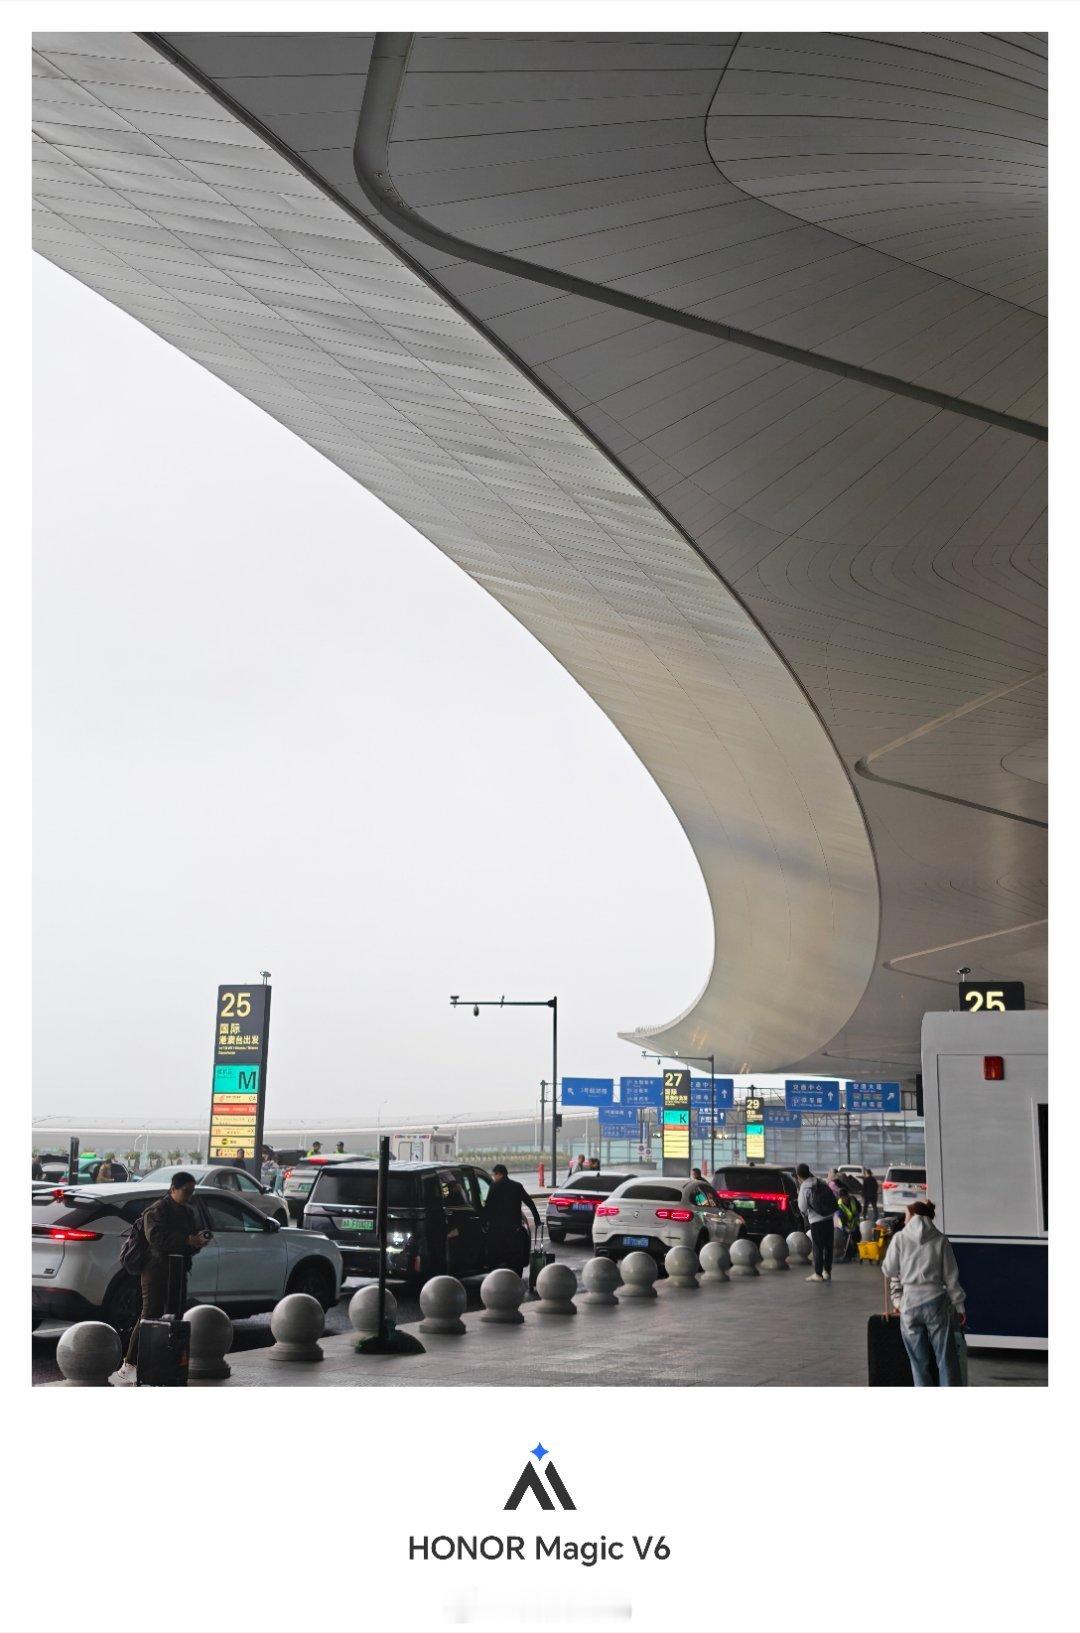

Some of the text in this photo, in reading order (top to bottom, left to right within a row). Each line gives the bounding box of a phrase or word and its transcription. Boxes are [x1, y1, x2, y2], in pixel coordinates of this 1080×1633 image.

[220, 991, 251, 1017] 25
[965, 991, 1006, 1013] 25
[219, 1023, 240, 1035] 国际
[239, 1072, 256, 1090] M
[664, 1072, 683, 1087] 27
[746, 1099, 760, 1110] 29
[680, 1114, 686, 1124] K
